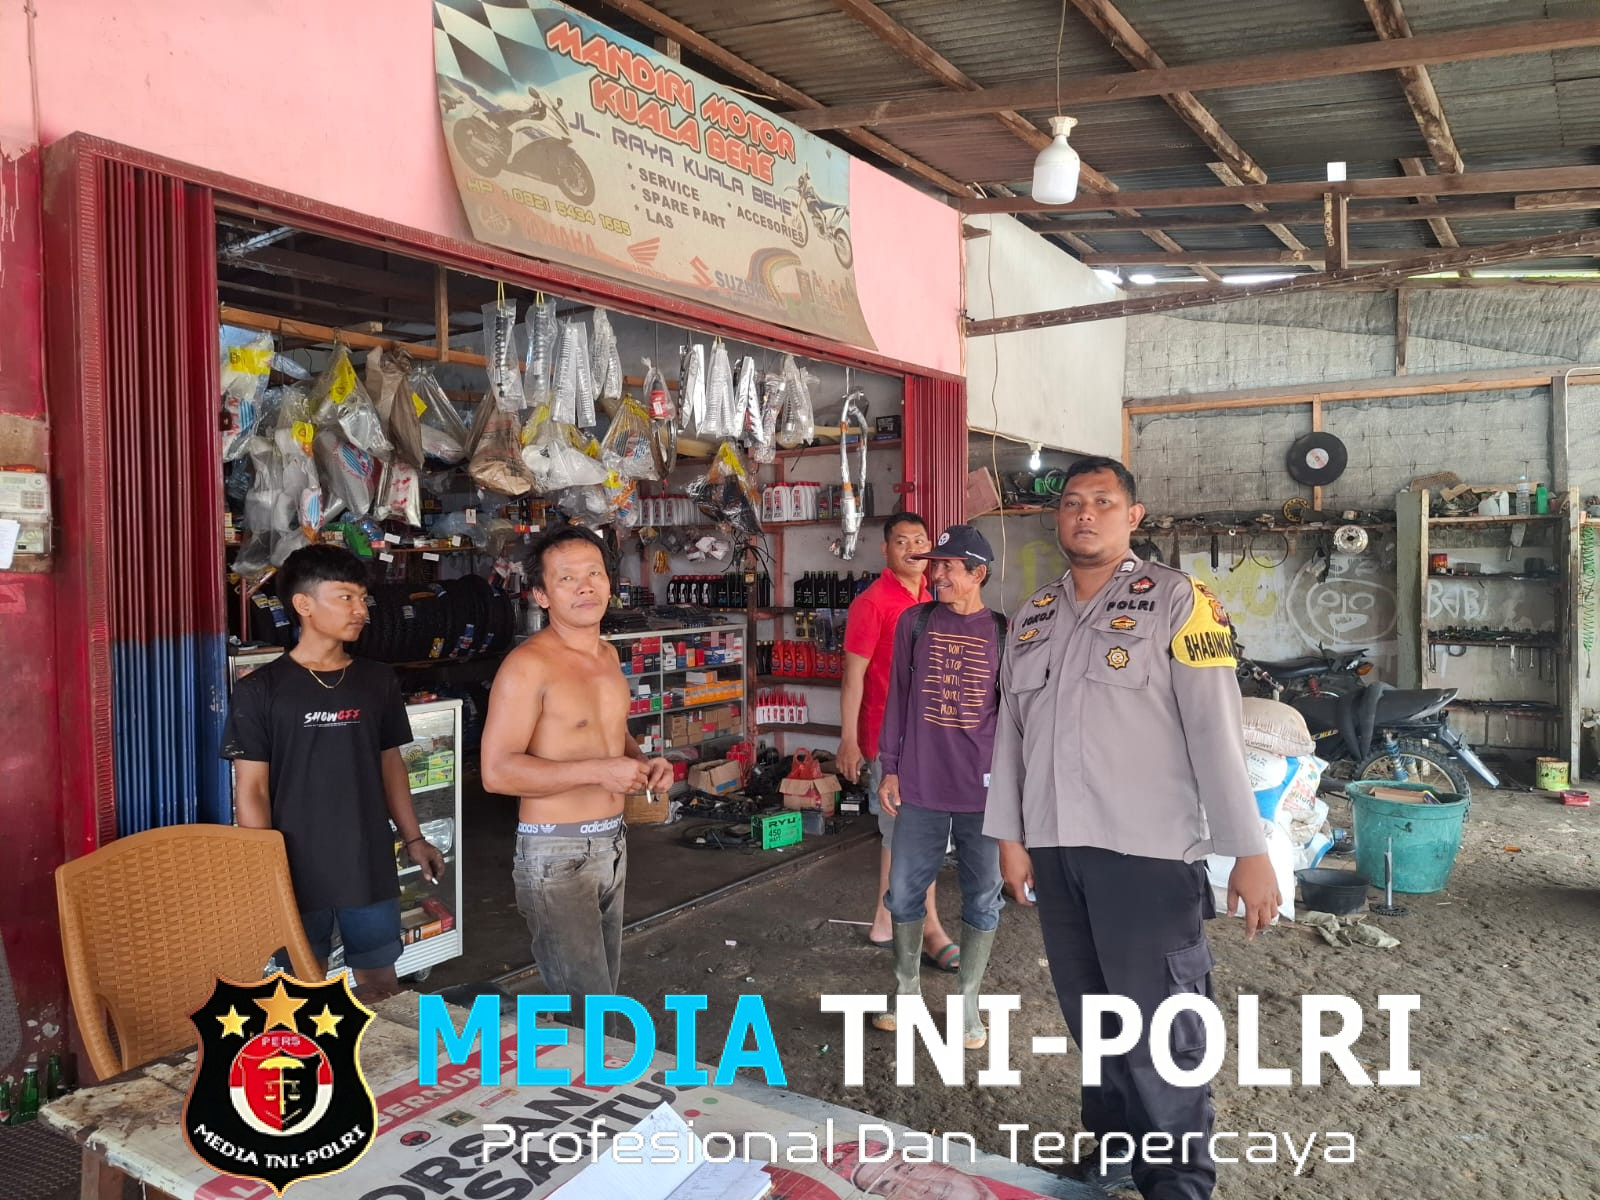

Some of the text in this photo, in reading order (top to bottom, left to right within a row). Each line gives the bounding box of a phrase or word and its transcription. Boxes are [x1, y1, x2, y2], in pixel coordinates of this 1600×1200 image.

[546, 21, 796, 163] MANDIRI MOTOR
[590, 75, 775, 185] KUALA BEHE
[569, 112, 792, 217] JL. RAYA KUALA BEHE
[639, 168, 700, 201] SERVICE
[643, 188, 726, 228] SPARE PART
[646, 208, 674, 230] LAS
[1106, 600, 1155, 612] POLRI
[945, 658, 962, 671] STOP
[942, 673, 960, 686] UNTIL
[768, 816, 796, 828] RYU
